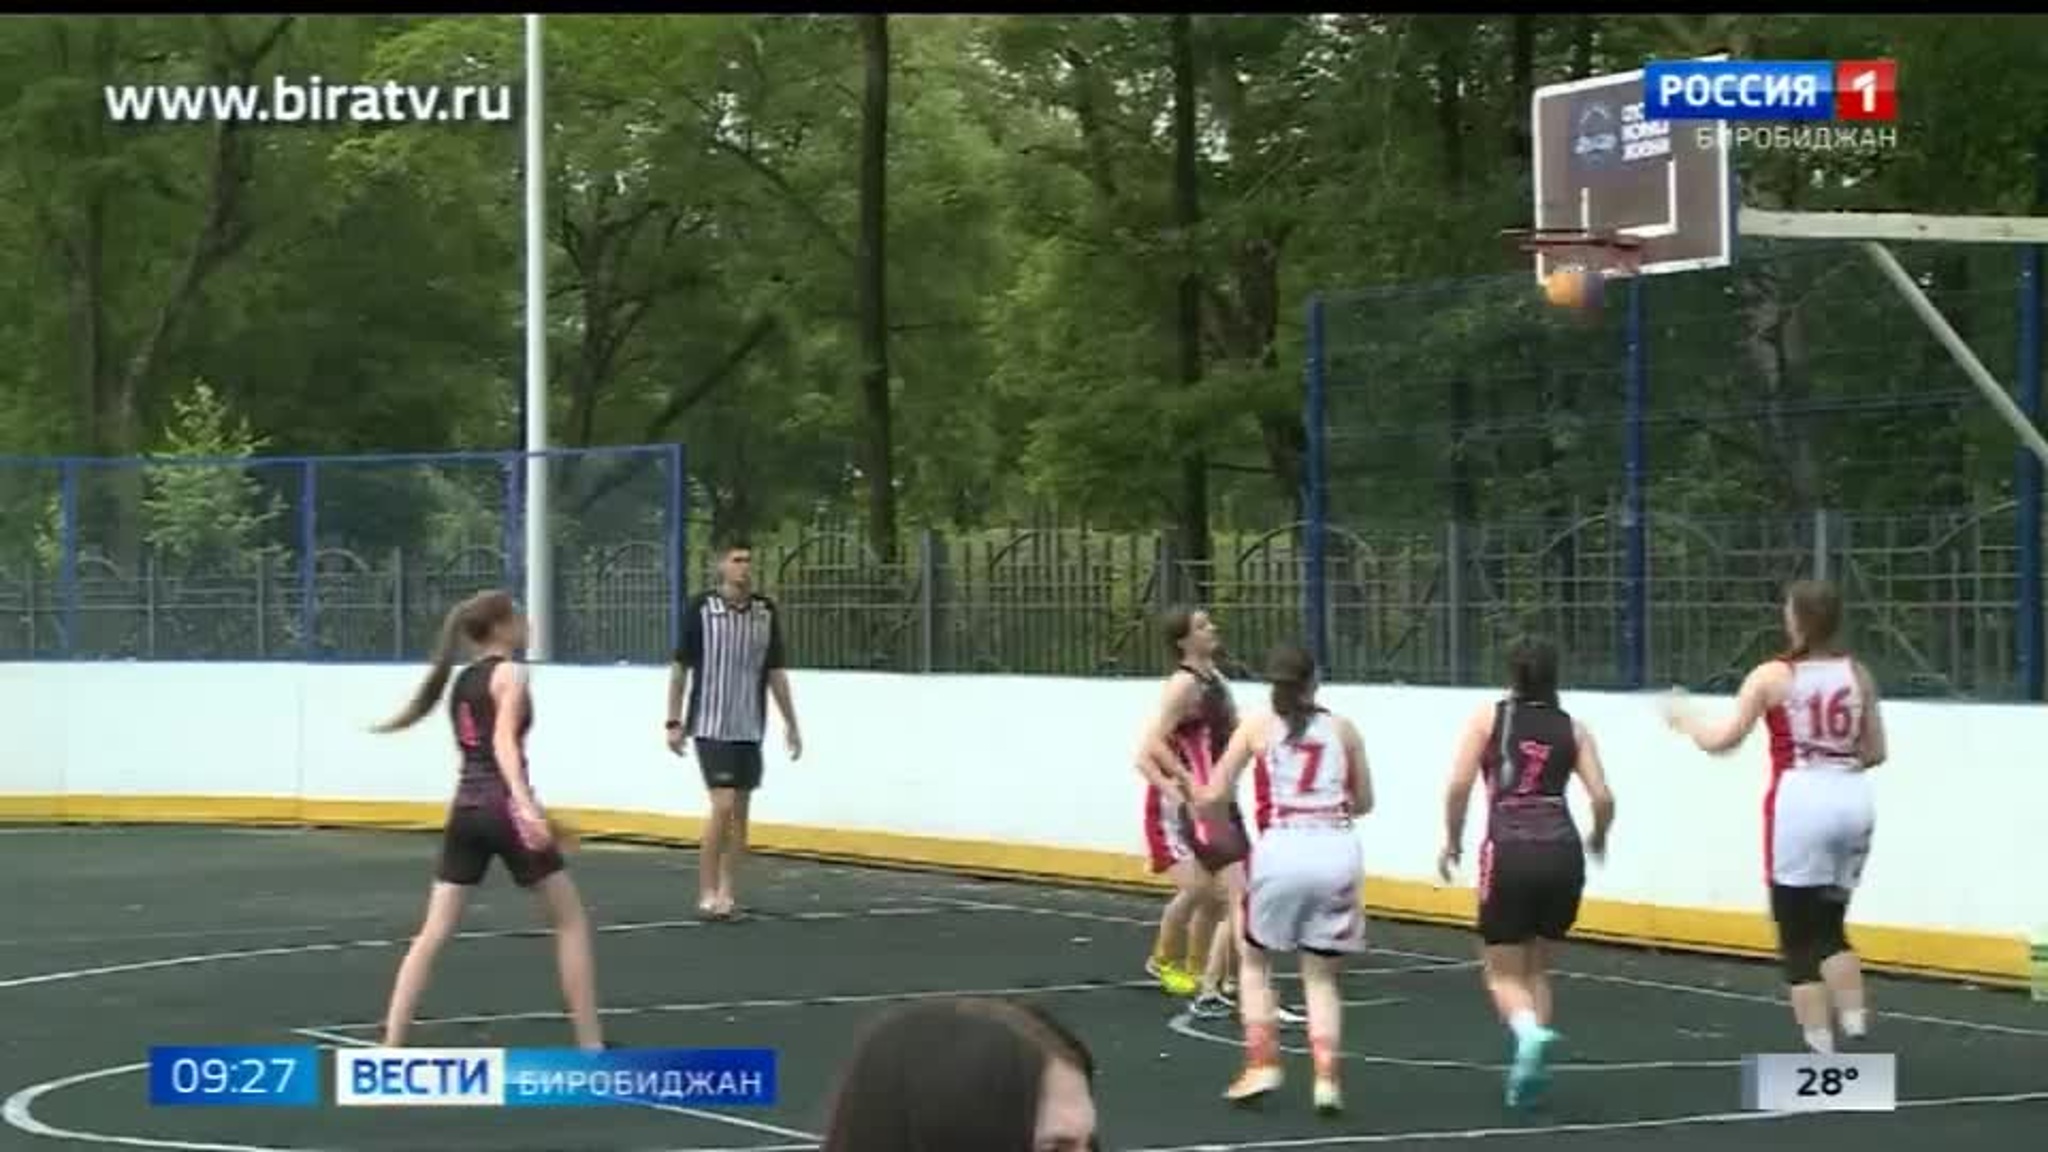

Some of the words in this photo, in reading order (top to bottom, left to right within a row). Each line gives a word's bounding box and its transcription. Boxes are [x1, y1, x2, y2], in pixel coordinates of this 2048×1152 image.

[1808, 688, 1852, 739] 16
[1297, 743, 1326, 792] 7
[1518, 740, 1553, 793] 7
